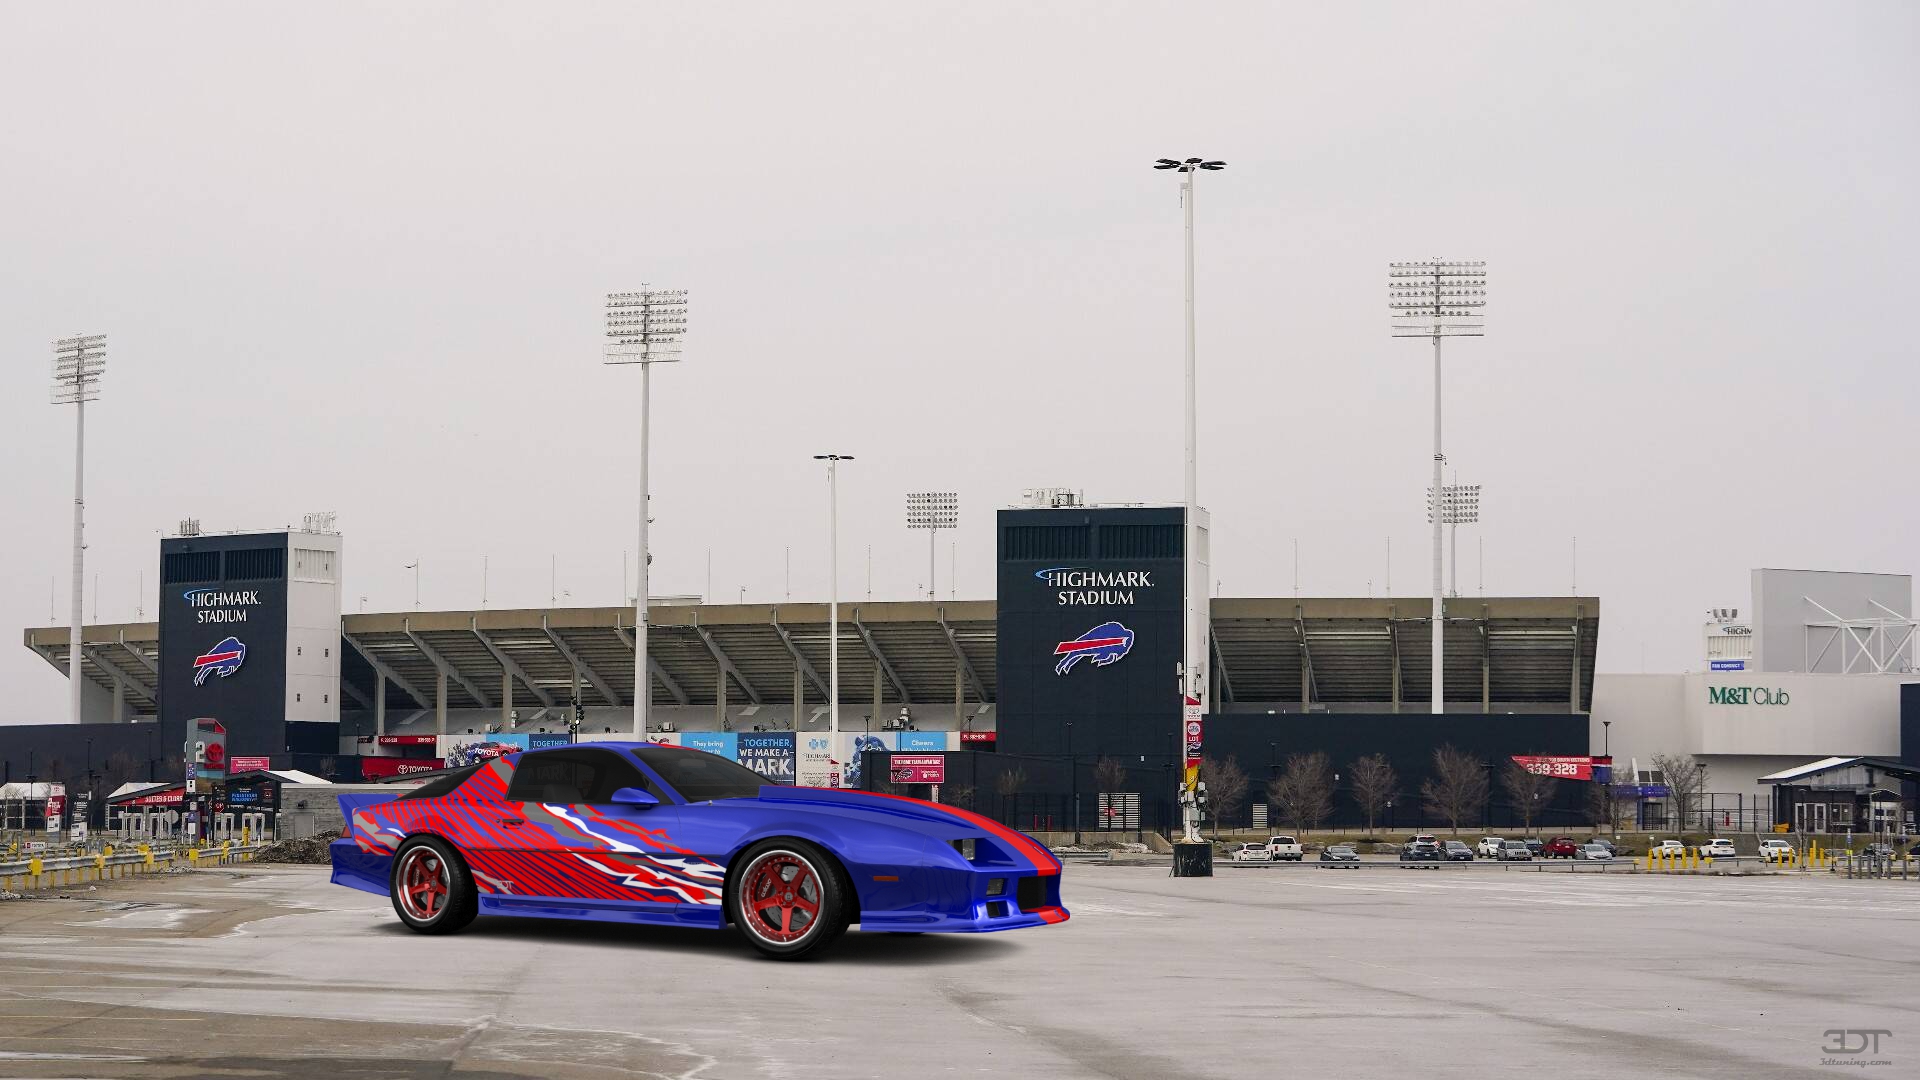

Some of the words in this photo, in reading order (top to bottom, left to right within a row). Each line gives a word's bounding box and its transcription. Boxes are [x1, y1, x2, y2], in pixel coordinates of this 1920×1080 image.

[1058, 590, 1134, 605] STADIUM
[198, 609, 247, 623] STADIUM
[1708, 686, 1752, 704] M&T
[1754, 687, 1790, 705] Club
[693, 741, 708, 749] They
[709, 741, 727, 749] bring
[743, 739, 793, 748] TOGETHER,
[474, 747, 499, 757] TOYOTA
[408, 765, 433, 773] TOYOTA
[737, 758, 794, 775] MARK.
